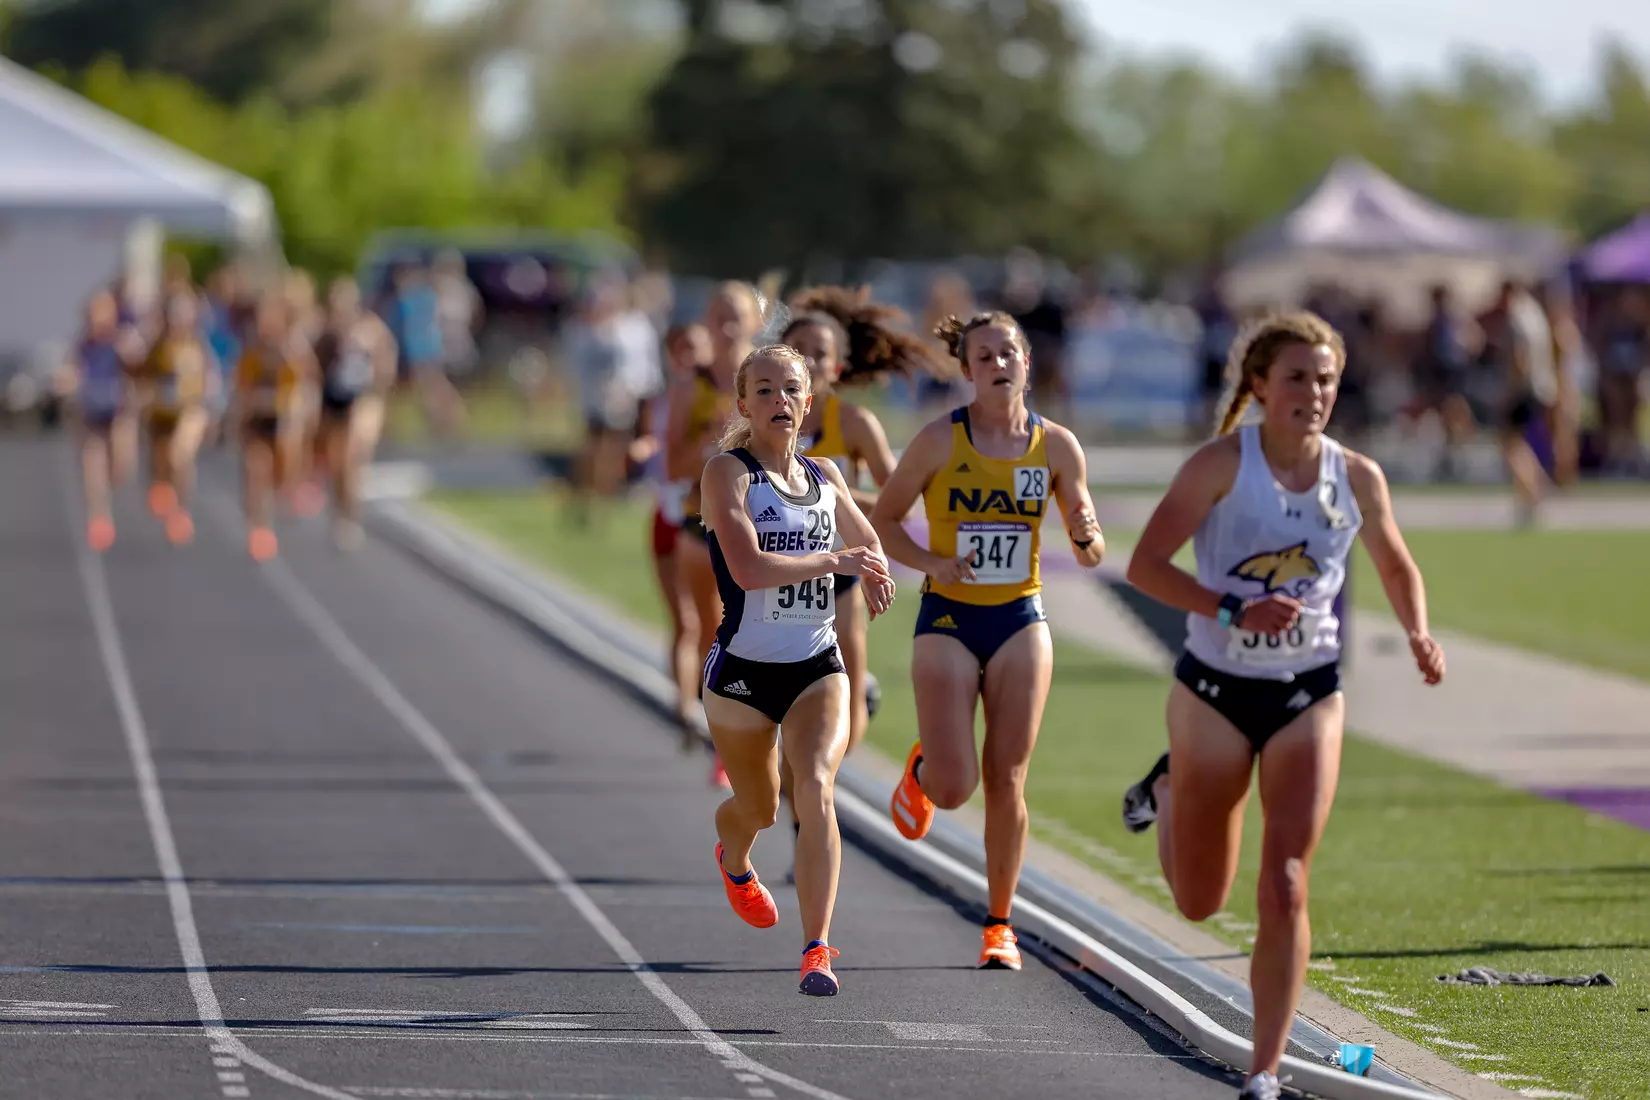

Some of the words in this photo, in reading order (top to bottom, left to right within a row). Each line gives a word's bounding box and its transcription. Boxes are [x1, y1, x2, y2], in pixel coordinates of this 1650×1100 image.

[1021, 469, 1044, 497] 28
[948, 488, 1042, 517] NAU
[755, 515, 782, 523] adidas
[807, 508, 832, 541] 29
[969, 535, 1019, 569] 347
[777, 577, 828, 610] 545
[723, 686, 752, 696] adidas
